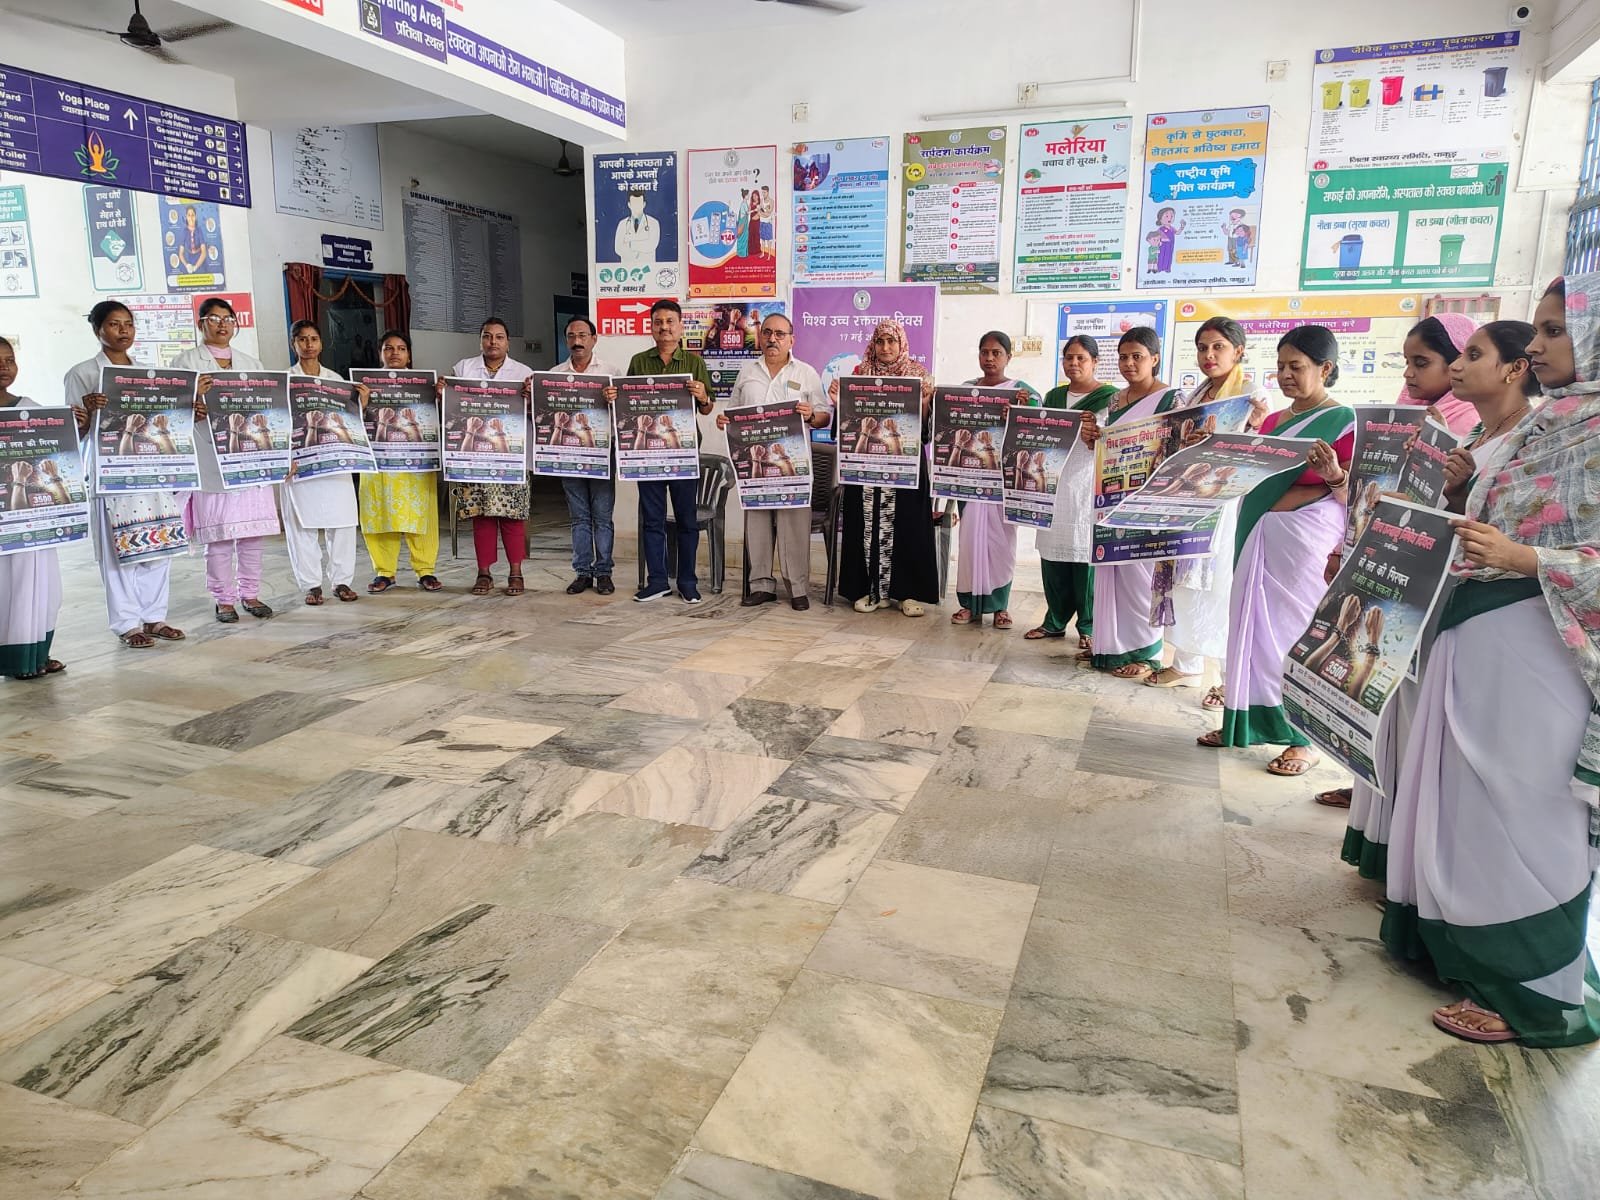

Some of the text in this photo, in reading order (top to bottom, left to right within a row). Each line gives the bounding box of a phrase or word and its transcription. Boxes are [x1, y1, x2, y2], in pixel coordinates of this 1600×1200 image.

[420, 6, 442, 30] Area
[424, 34, 445, 52] स्थल
[448, 31, 476, 58] स्वच्छता
[478, 45, 506, 72] अपनाओ
[508, 53, 520, 78] रोग
[58, 90, 110, 111] Yoga Place
[591, 96, 597, 111] का
[611, 105, 614, 119] न
[183, 131, 198, 140] Ward
[1167, 130, 1187, 143] कृमि
[1193, 130, 1202, 138] से
[921, 144, 990, 157] सर्पदंश कार्यक्रम
[1045, 137, 1106, 155] मलेरिया
[1194, 143, 1226, 153] भविष्य
[1231, 142, 1260, 151] हमारा
[599, 155, 673, 168] आपकी अस्वच्छता से
[1066, 157, 1074, 166] ही
[1102, 154, 1108, 163] है
[611, 168, 658, 180] आपके अपनों
[1176, 165, 1230, 179] राष्ट्रीय कृमि
[617, 179, 658, 191] को खतरा है
[1197, 179, 1235, 191] कार्यक्रम
[1324, 188, 1344, 203] सफाई
[1346, 188, 1355, 200] को
[1393, 188, 1422, 199] अस्पताल
[1425, 184, 1434, 197] को
[1437, 186, 1455, 197] स्वच्छ
[410, 192, 429, 201] URBAN
[431, 196, 454, 207] PRIMARY
[456, 202, 474, 212] HEALTH
[1317, 220, 1332, 229] नीला
[1370, 218, 1390, 228] कचरा)
[1416, 219, 1427, 227] हरा
[1446, 215, 1467, 226] (गीला
[1471, 214, 1493, 225] कचरा)
[367, 252, 371, 261] 2
[236, 312, 250, 325] XIT
[803, 312, 827, 326] विश्व
[830, 316, 849, 326] उच्च
[895, 311, 923, 326] दिवस
[1259, 320, 1289, 329] मलेरिया
[602, 319, 635, 334] FIRE
[723, 335, 740, 343] 3500
[851, 331, 862, 342] मई
[1107, 438, 1118, 448] विश्व
[1140, 430, 1155, 441] निषेध
[1156, 426, 1172, 438] दिवस
[1415, 531, 1436, 550] दिवस
[1365, 561, 1376, 573] लत
[1376, 563, 1388, 577] की
[1325, 661, 1348, 679] 3500
